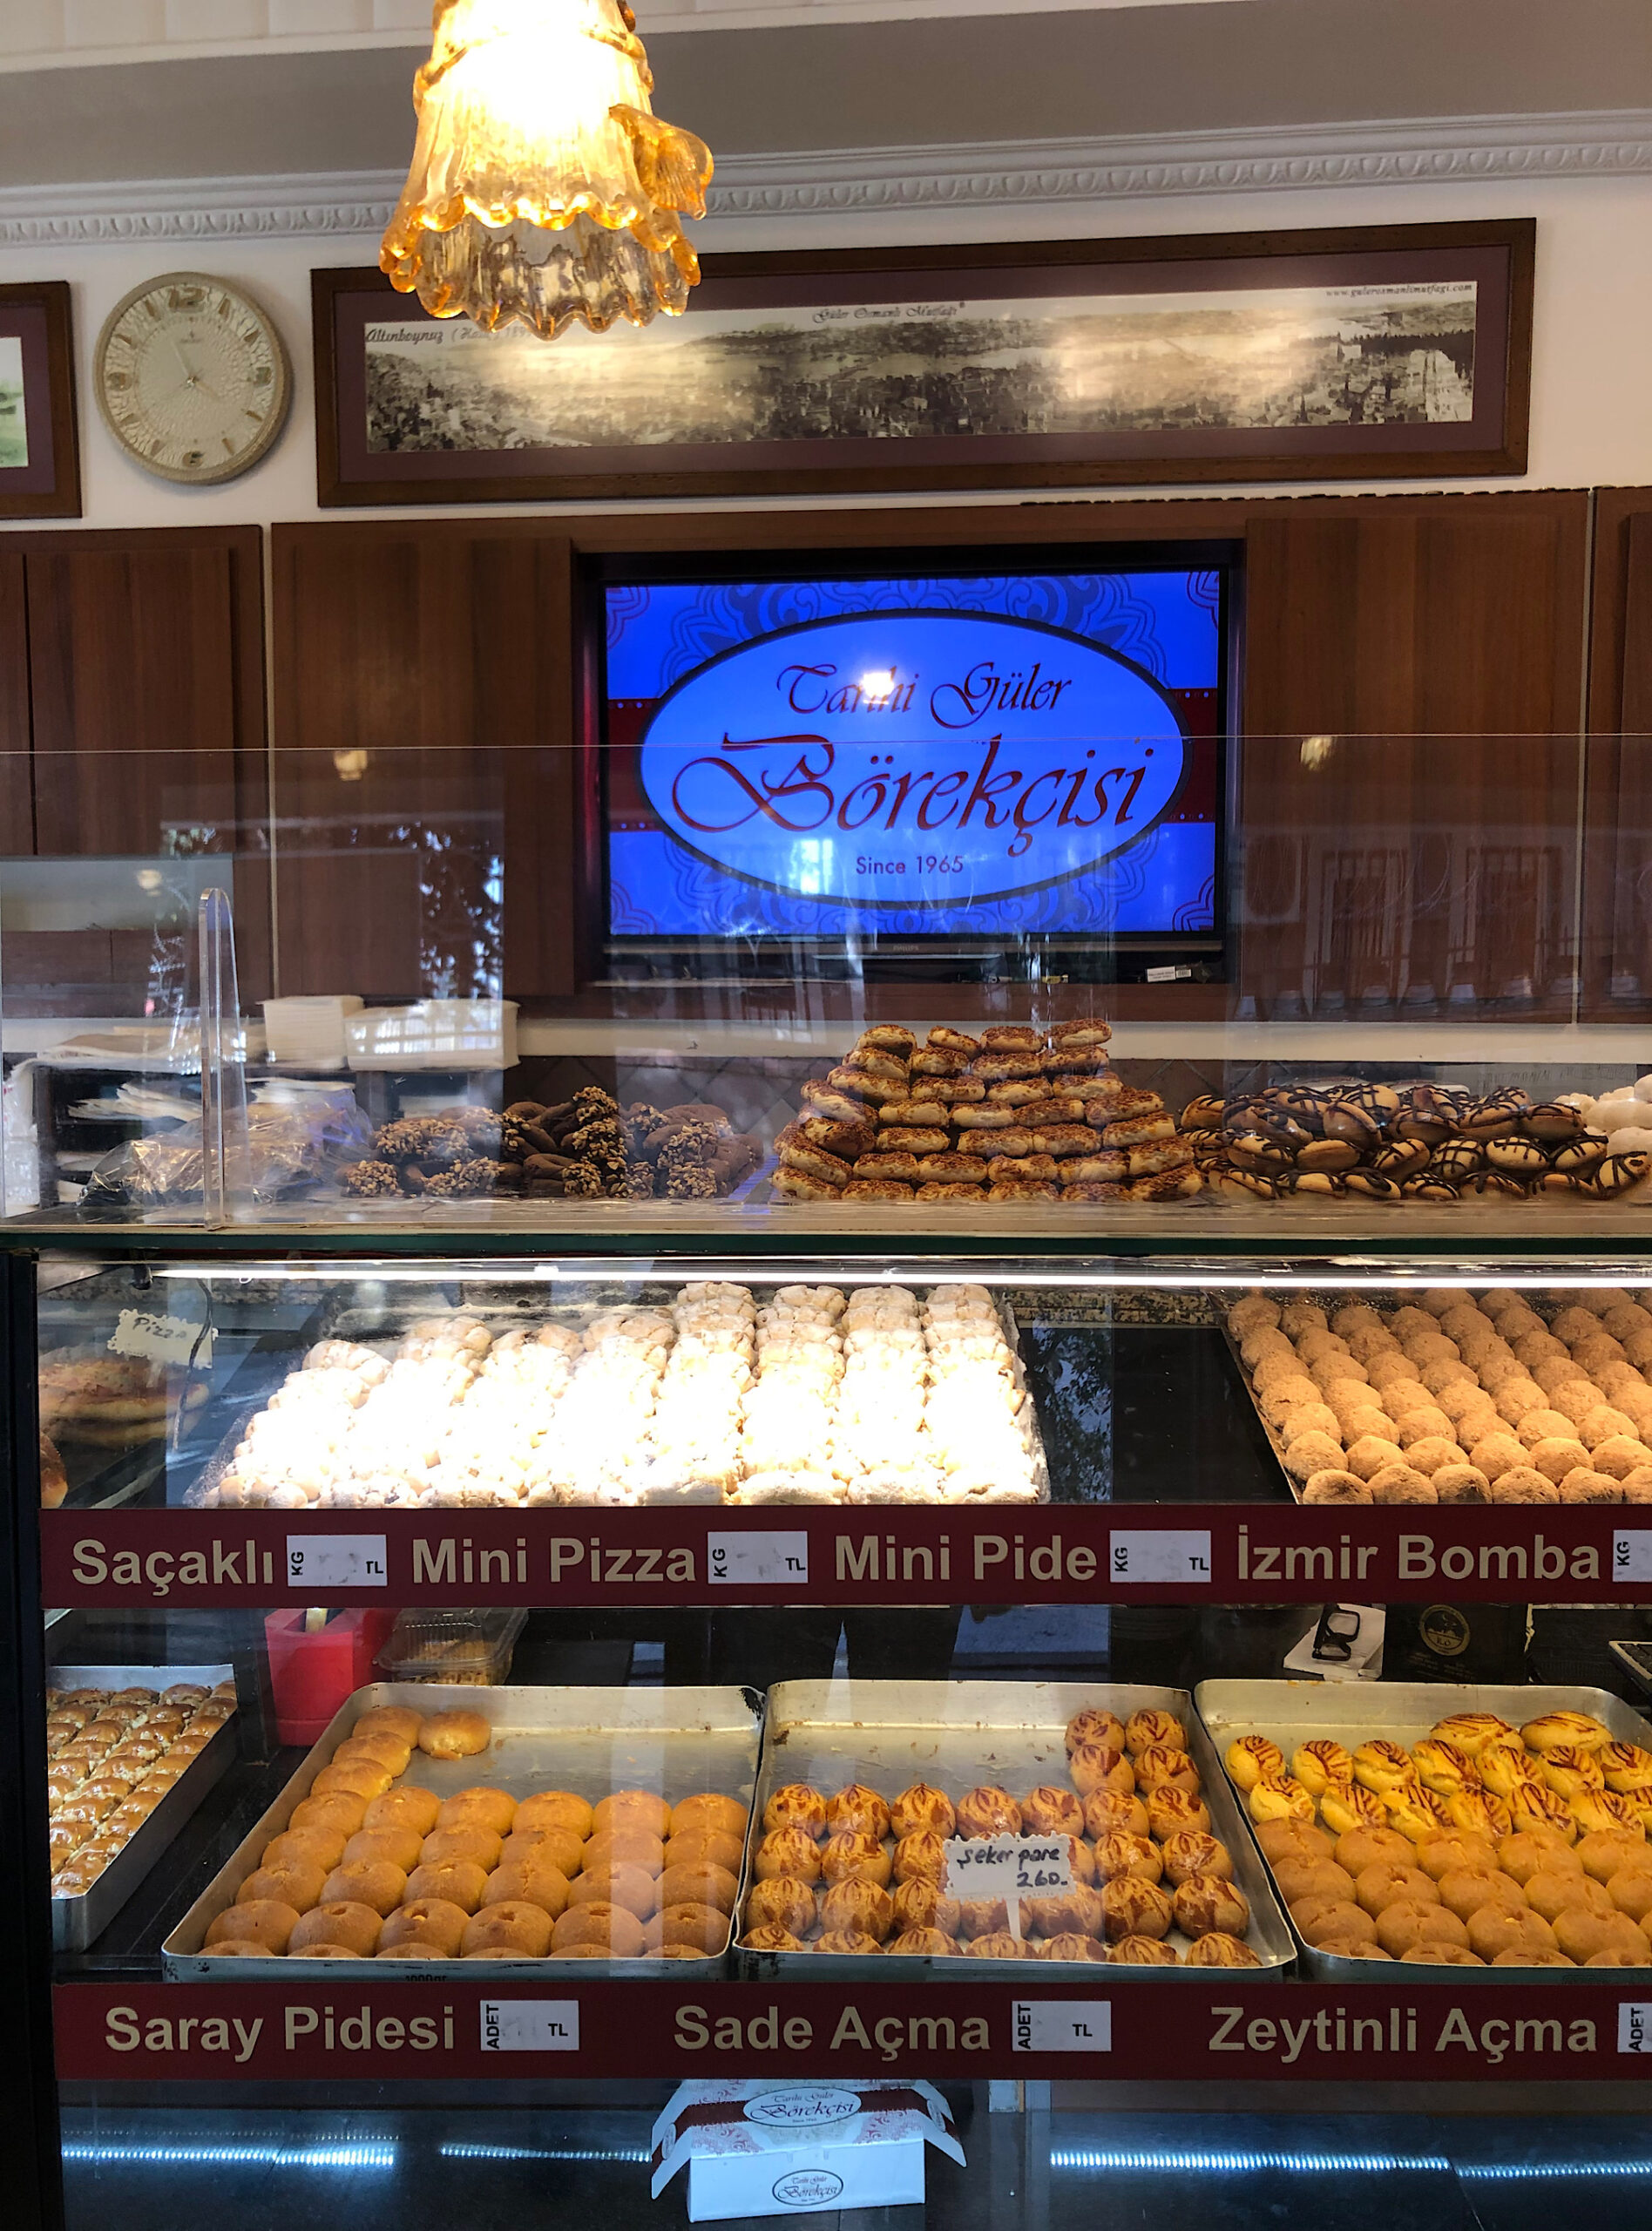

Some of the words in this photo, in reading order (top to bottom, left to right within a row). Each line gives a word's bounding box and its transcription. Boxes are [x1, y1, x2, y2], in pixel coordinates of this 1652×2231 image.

[776, 663, 919, 715] Tarhi
[930, 661, 1072, 729] Güler
[672, 733, 1147, 858] Börekçisi
[855, 856, 907, 875] Since
[915, 854, 965, 874] 1965
[71, 1539, 274, 1597] Saçaklı
[290, 1550, 305, 1577] KG
[365, 1560, 385, 1575] TL
[412, 1538, 527, 1583] Mini
[550, 1537, 696, 1583] Pizza
[712, 1547, 728, 1578] KG
[784, 1556, 807, 1571] TL
[836, 1535, 951, 1581] Mini
[974, 1535, 1098, 1581] Pide
[1114, 1546, 1129, 1572] KG
[1188, 1556, 1210, 1571] TL
[1238, 1524, 1379, 1580] İzmir
[1398, 1534, 1601, 1580] Bomba
[1616, 1540, 1631, 1567] KG
[1018, 1848, 1060, 1871] pare
[105, 2006, 263, 2063] Saray
[284, 2006, 454, 2051] Pidesi
[485, 2004, 500, 2050] ADET
[547, 2023, 569, 2037] TL
[674, 2005, 814, 2051] Sade
[829, 2006, 992, 2062] Açma
[1017, 2004, 1032, 2050] ADET
[1071, 2023, 1093, 2038] TL
[1209, 2007, 1418, 2064] Zeytinli
[1434, 2008, 1598, 2064] Açma
[1628, 2007, 1642, 2051] ADET
[749, 2100, 855, 2119] Börekçisi
